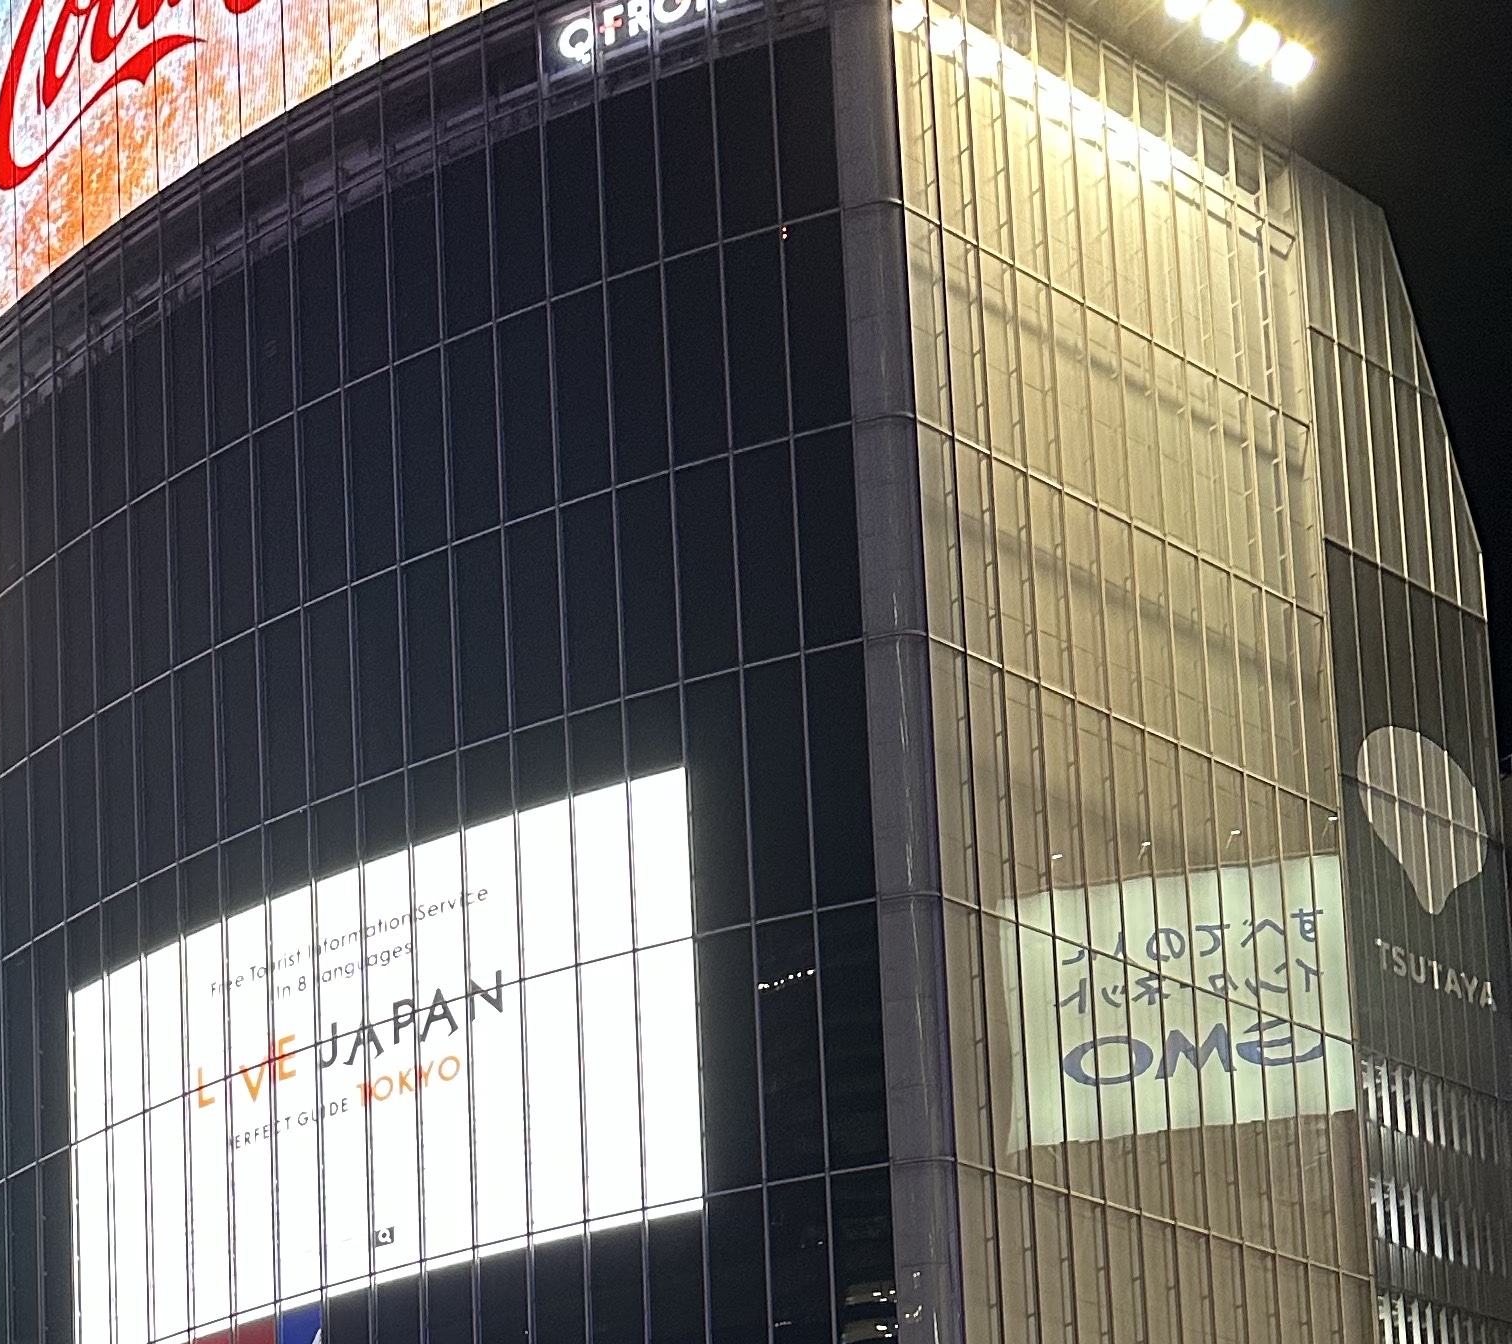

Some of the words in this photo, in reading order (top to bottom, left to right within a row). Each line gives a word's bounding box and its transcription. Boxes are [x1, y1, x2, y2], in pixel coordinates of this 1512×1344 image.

[558, 0, 728, 64] QFRO
[250, 950, 301, 981] Tourist
[417, 888, 489, 920] Service
[299, 976, 306, 990] 8
[317, 942, 412, 982] anguages
[1375, 939, 1496, 1012] TSUTAYA
[197, 1034, 296, 1108] LVE
[320, 970, 503, 1068] JAPAN
[356, 1055, 460, 1107] TOKYO
